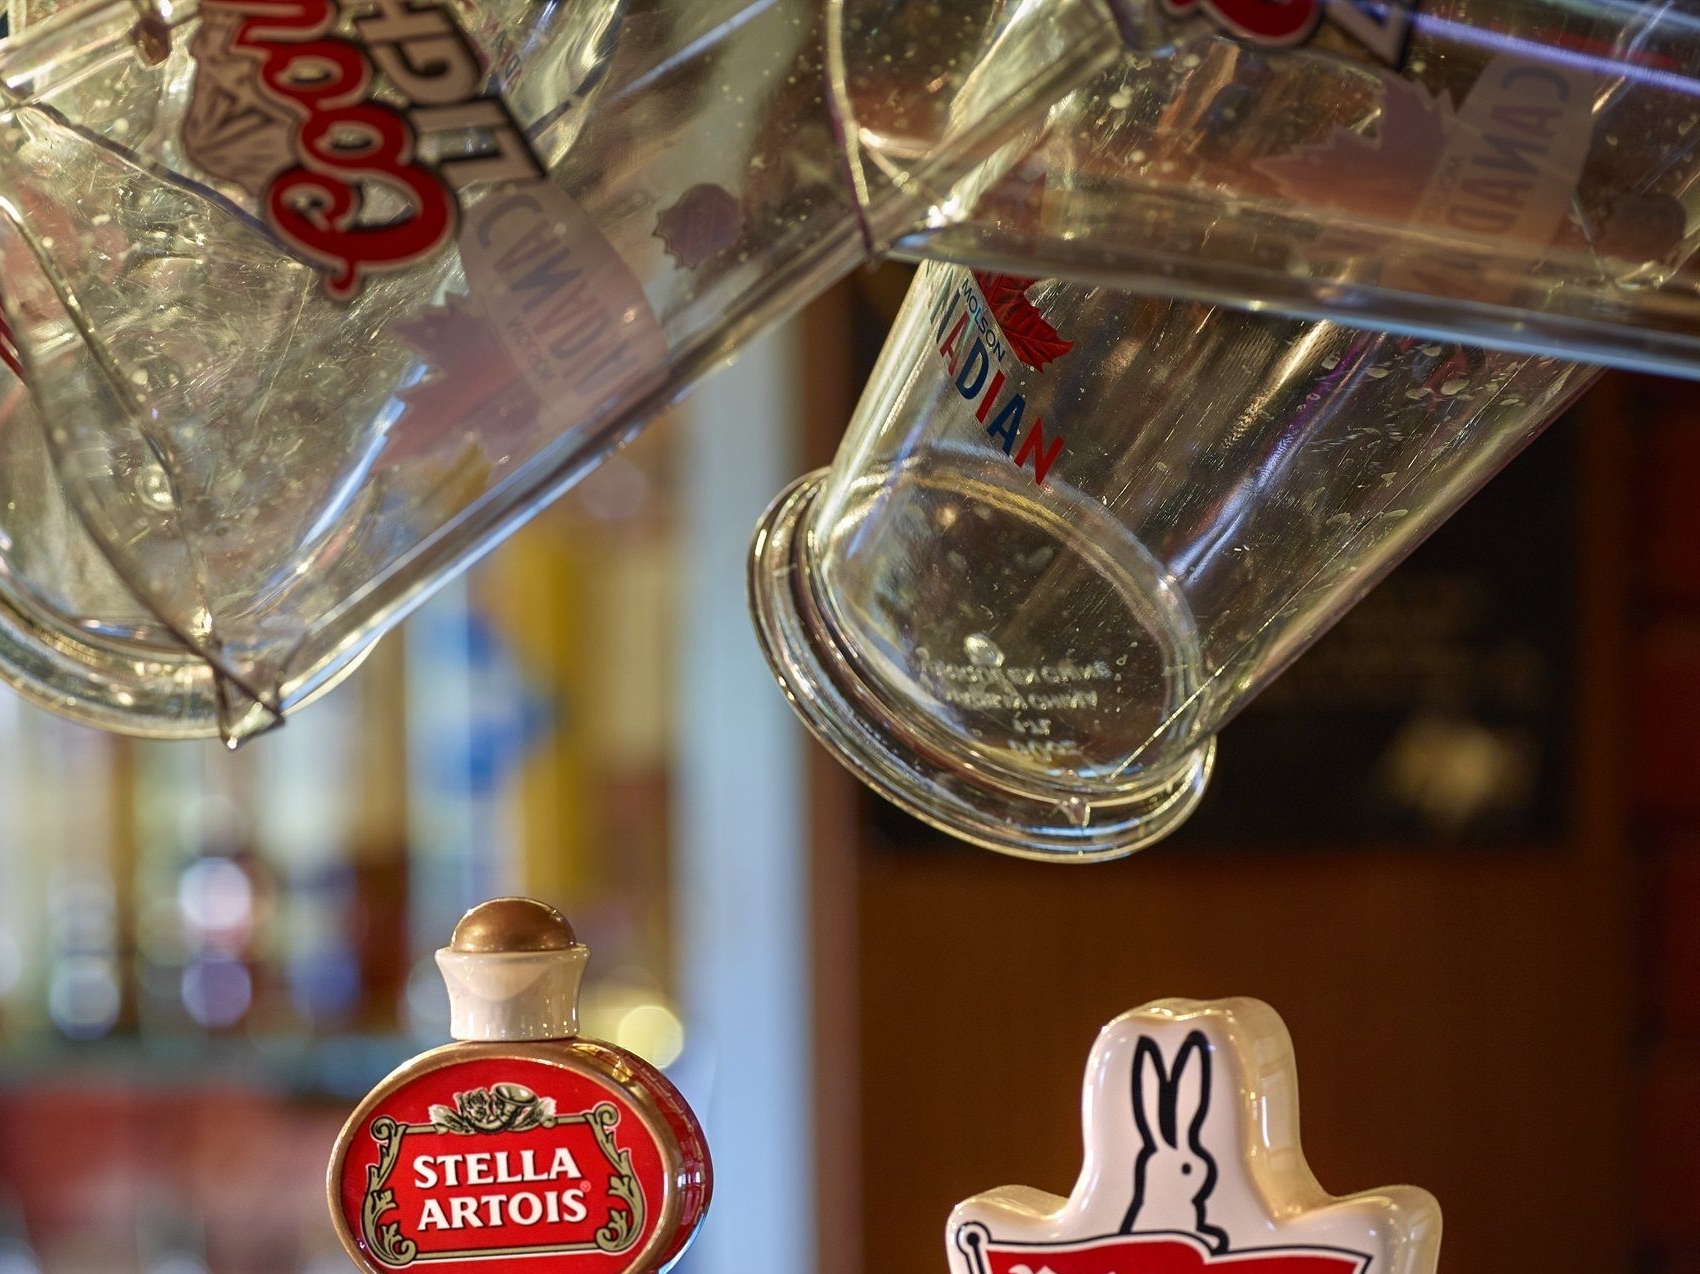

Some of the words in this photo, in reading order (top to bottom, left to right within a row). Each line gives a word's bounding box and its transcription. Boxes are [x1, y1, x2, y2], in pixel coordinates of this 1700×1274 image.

[961, 277, 1006, 363] MOLSON
[412, 1147, 583, 1189] STELLA
[417, 1188, 588, 1232] ARTOIS
